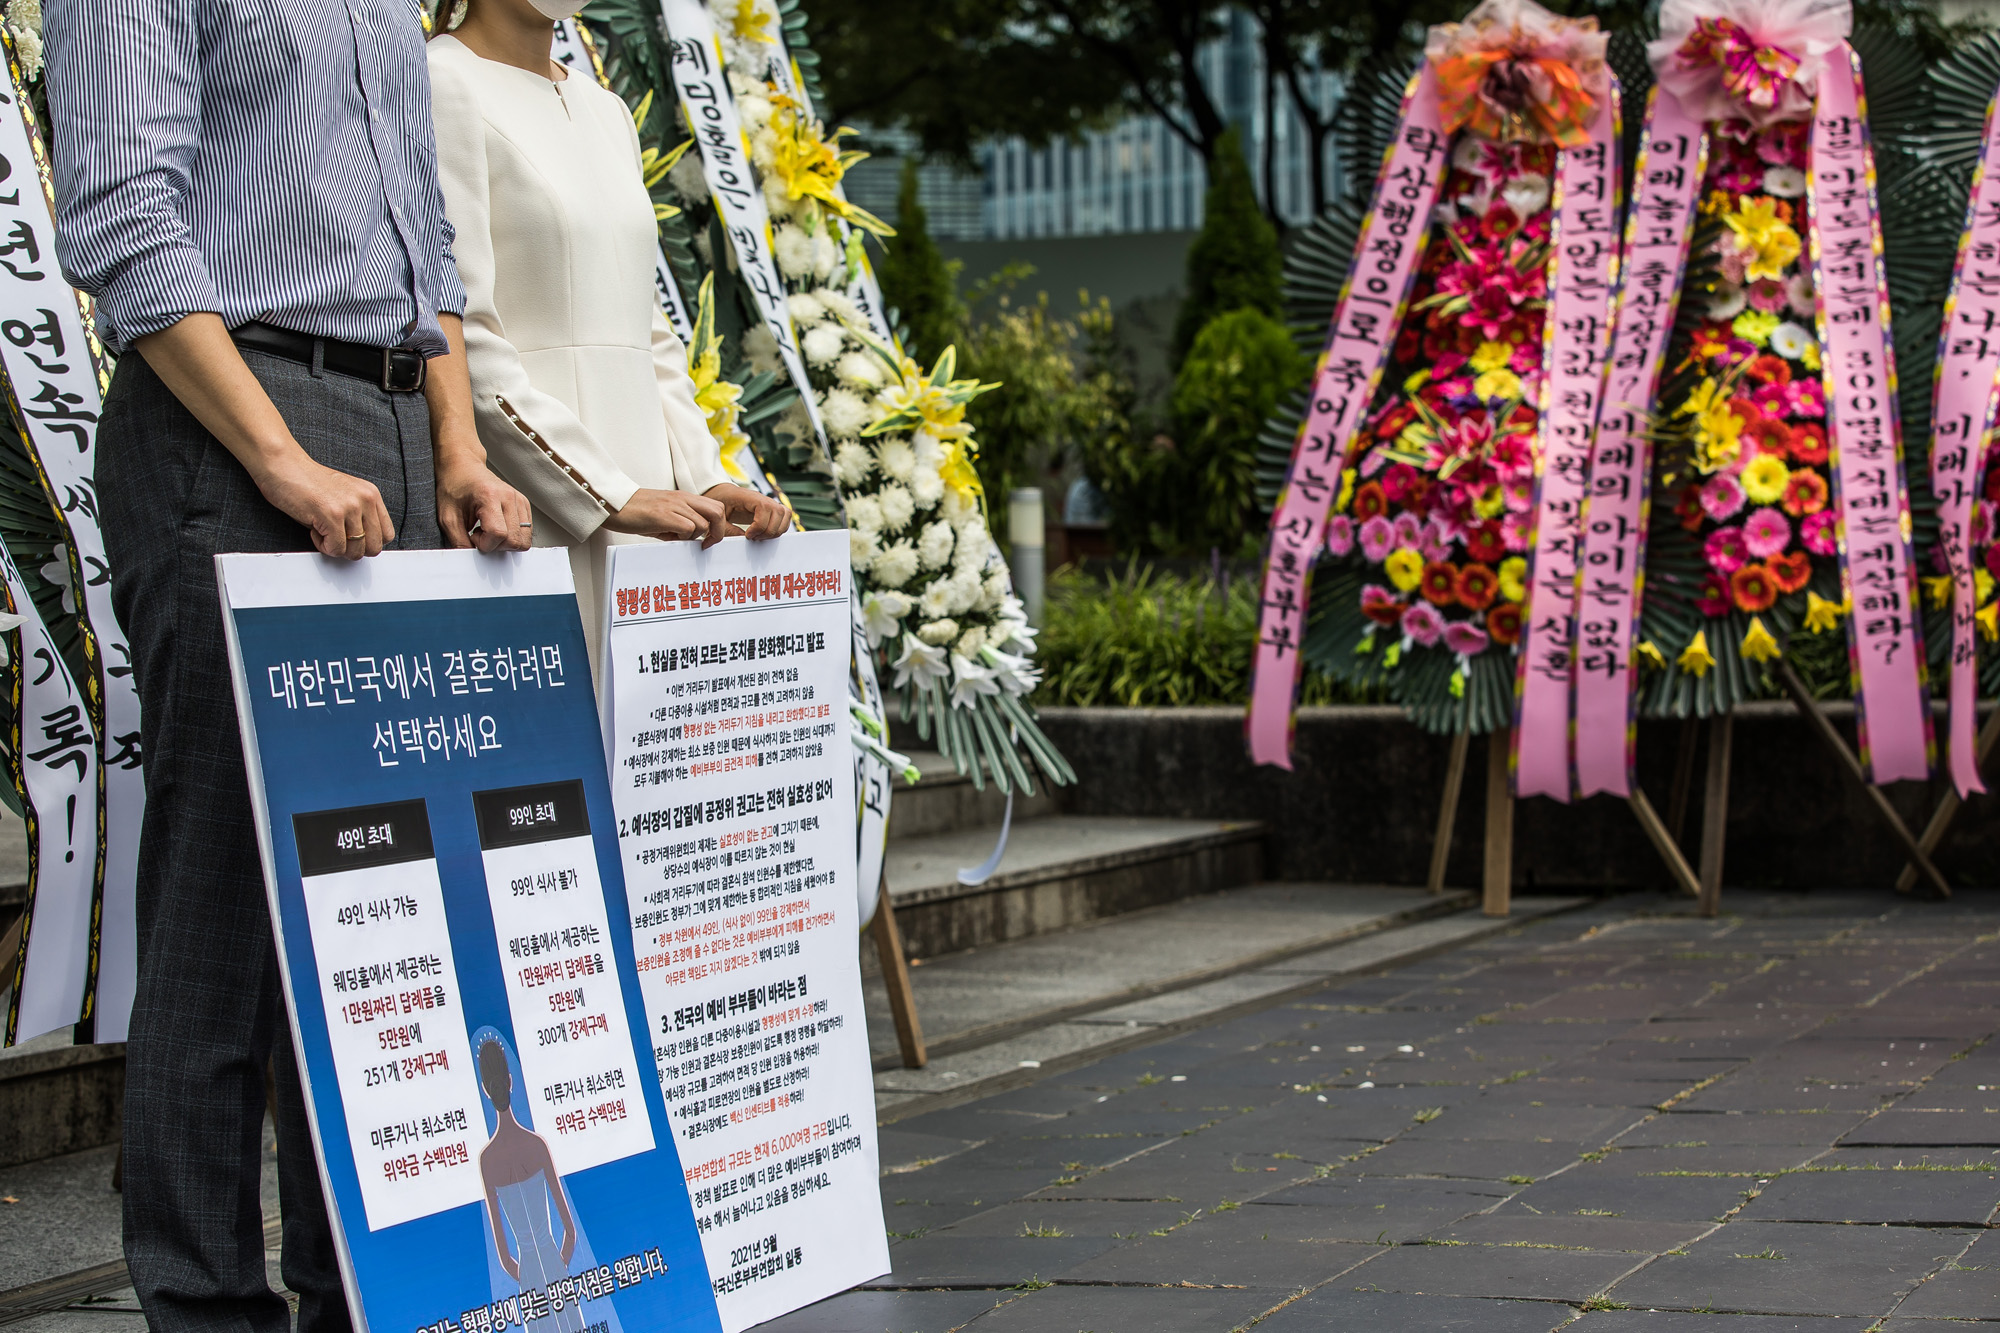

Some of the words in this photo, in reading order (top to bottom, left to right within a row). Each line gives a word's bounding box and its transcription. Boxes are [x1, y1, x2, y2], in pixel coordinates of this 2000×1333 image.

[2, 308, 97, 453] 연속
[1593, 411, 1634, 501] 미래의
[1938, 413, 1972, 508] 미래가
[1584, 515, 1637, 607] 아이는
[615, 585, 650, 617] 형평성
[652, 583, 676, 613] 없는
[677, 578, 723, 610] 결혼식장
[724, 575, 757, 604] 지침에
[759, 573, 781, 601] 대해
[782, 568, 841, 599] 재수정하라!
[1260, 516, 1312, 659] 신혼부부
[638, 654, 648, 673] 1.
[650, 649, 678, 673] 현실을
[679, 646, 698, 669] 전혀
[699, 643, 727, 665] 모르는
[728, 639, 756, 661] 조치를
[757, 634, 804, 659] 완화했다고
[806, 631, 825, 653] 발표
[1582, 617, 1628, 680] 없다
[267, 652, 436, 709] 대한민국에서
[442, 643, 565, 694] 결혼하려면
[372, 712, 502, 767] 선택하세요
[509, 804, 534, 825] 99인
[535, 801, 556, 821] 초대
[619, 818, 629, 838] 2.
[631, 807, 671, 836] 예식장의
[673, 801, 703, 829] 갑질에
[705, 796, 734, 822] 공정위
[736, 792, 765, 816] 권고는
[766, 786, 784, 811] 전혀
[786, 781, 813, 807] 실효성
[815, 778, 832, 801] 없어
[337, 826, 365, 849] 49인
[367, 823, 392, 844] 초대
[510, 875, 535, 896] 99인
[536, 871, 556, 893] 식사
[558, 868, 578, 890] 불가
[337, 902, 365, 925] 49인
[367, 898, 391, 921] 식사
[392, 894, 417, 917] 가능
[509, 930, 560, 958] 웨딩홀에서
[560, 924, 600, 948] 제공하는
[333, 961, 393, 992] 웨딩홀에서
[395, 953, 442, 980] 제공하는
[518, 961, 564, 988] 1만원짜리
[564, 953, 604, 979] 답례품을
[341, 994, 397, 1024] 1만원짜리
[399, 984, 445, 1014] 답례품을
[548, 987, 585, 1012] 5만원에
[660, 1014, 672, 1034] 3.
[674, 1002, 704, 1031] 전국의
[706, 996, 726, 1021] 예비
[728, 985, 766, 1016] 부부들이
[767, 979, 796, 1004] 바라는
[797, 974, 807, 996] 점
[378, 1022, 422, 1050] 5만원에
[537, 1022, 568, 1046] 300개
[567, 1013, 609, 1040] 강제구매
[363, 1060, 400, 1087] 251개
[400, 1049, 449, 1079] 강제구매
[543, 1078, 584, 1105] 미루거나
[586, 1069, 625, 1095] 취소하면
[370, 1119, 419, 1150] 미루거나
[421, 1108, 467, 1138] 취소하면
[555, 1109, 586, 1134] 위약금
[587, 1098, 627, 1126] 수백만원
[383, 1153, 419, 1182] 위약금
[422, 1141, 469, 1172] 수백만원
[519, 1289, 549, 1323] 맞는
[549, 1263, 614, 1311] 방역지침을
[614, 1247, 668, 1288] 원합니다.
